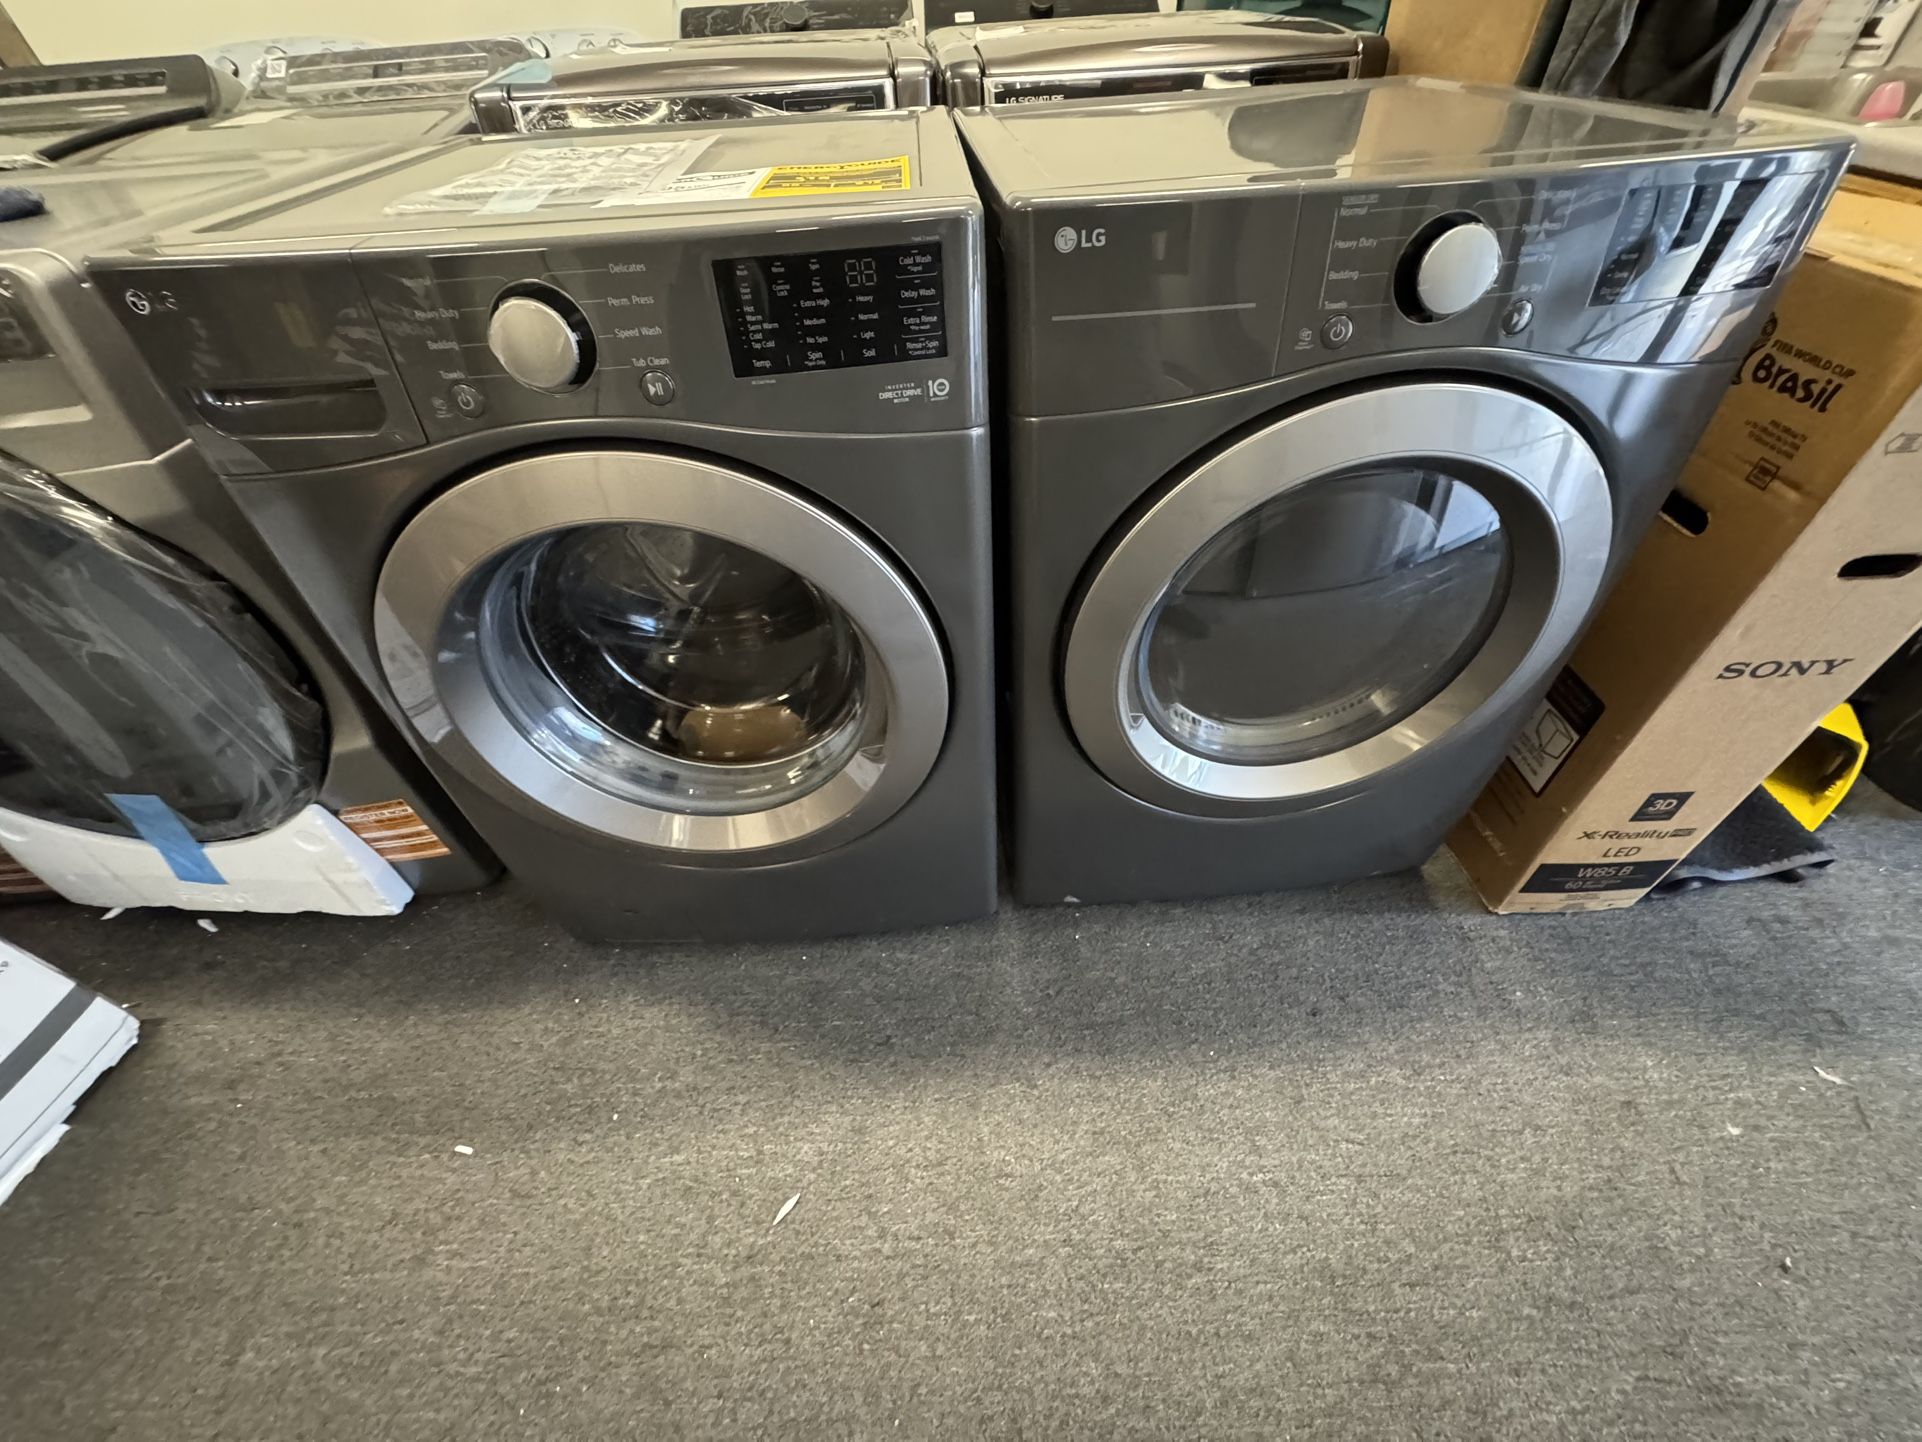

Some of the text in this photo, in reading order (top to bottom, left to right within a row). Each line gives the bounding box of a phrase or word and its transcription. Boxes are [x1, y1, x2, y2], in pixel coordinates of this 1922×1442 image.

[1081, 228, 1106, 248] LG
[1334, 237, 1378, 249] Heavy Duty
[899, 254, 932, 265] Cold Wash
[608, 263, 646, 274] Delicates
[856, 295, 873, 303] Heavy
[901, 288, 936, 299] Delay Wash
[632, 295, 655, 305] Press
[816, 298, 831, 308] High
[743, 305, 755, 313] Hot
[858, 312, 879, 320] Normal
[903, 316, 920, 325] Extra
[803, 318, 826, 326] Medium
[614, 326, 662, 339] Speed Wash
[860, 331, 875, 339] Light
[751, 340, 775, 349] Tap Cold
[806, 336, 828, 344] No Spin
[807, 351, 823, 360] Spin
[863, 348, 876, 357] Soil
[632, 357, 670, 368] Tub Clean
[1794, 349, 1832, 370] WORLD
[1831, 364, 1857, 380] CUP
[928, 378, 950, 397] 10
[1752, 353, 1844, 413] Brasil
[879, 387, 922, 400] DIRECT DRIVE
[1714, 658, 1856, 680] SONY
[1649, 799, 1678, 812] 3D
[1602, 847, 1642, 858] LED
[1565, 881, 1582, 889] 60
